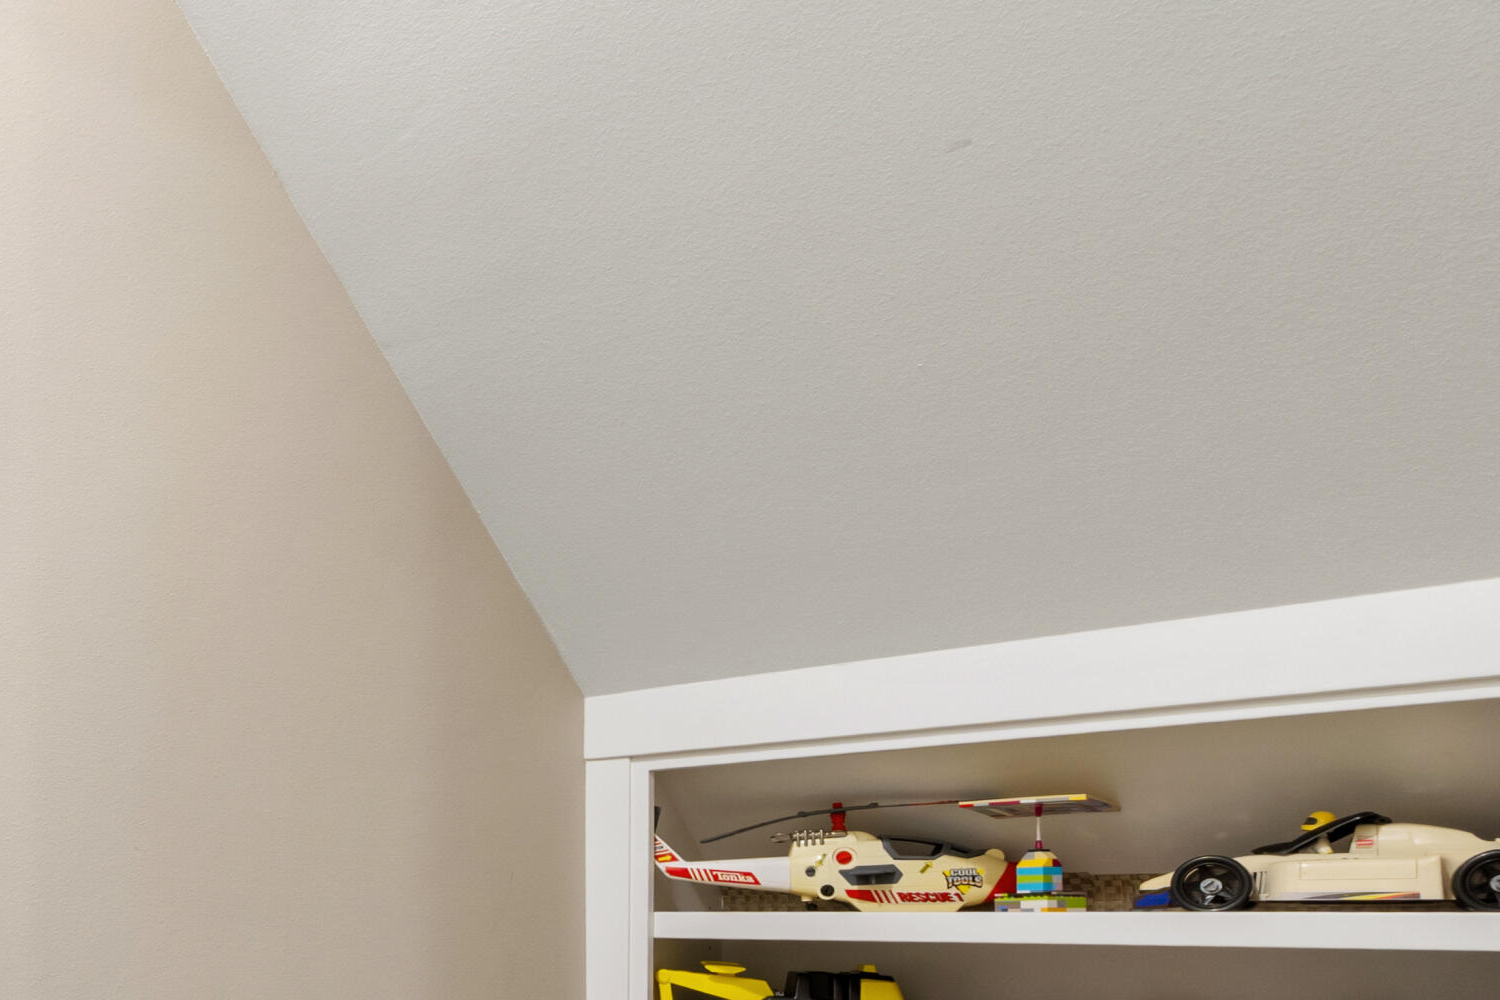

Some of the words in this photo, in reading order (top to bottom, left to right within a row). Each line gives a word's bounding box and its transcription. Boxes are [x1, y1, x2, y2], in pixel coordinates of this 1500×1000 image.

[713, 871, 755, 883] Tonka
[950, 868, 978, 877] COOL
[947, 876, 983, 889] TOOLS
[897, 892, 955, 902] RESCUE
